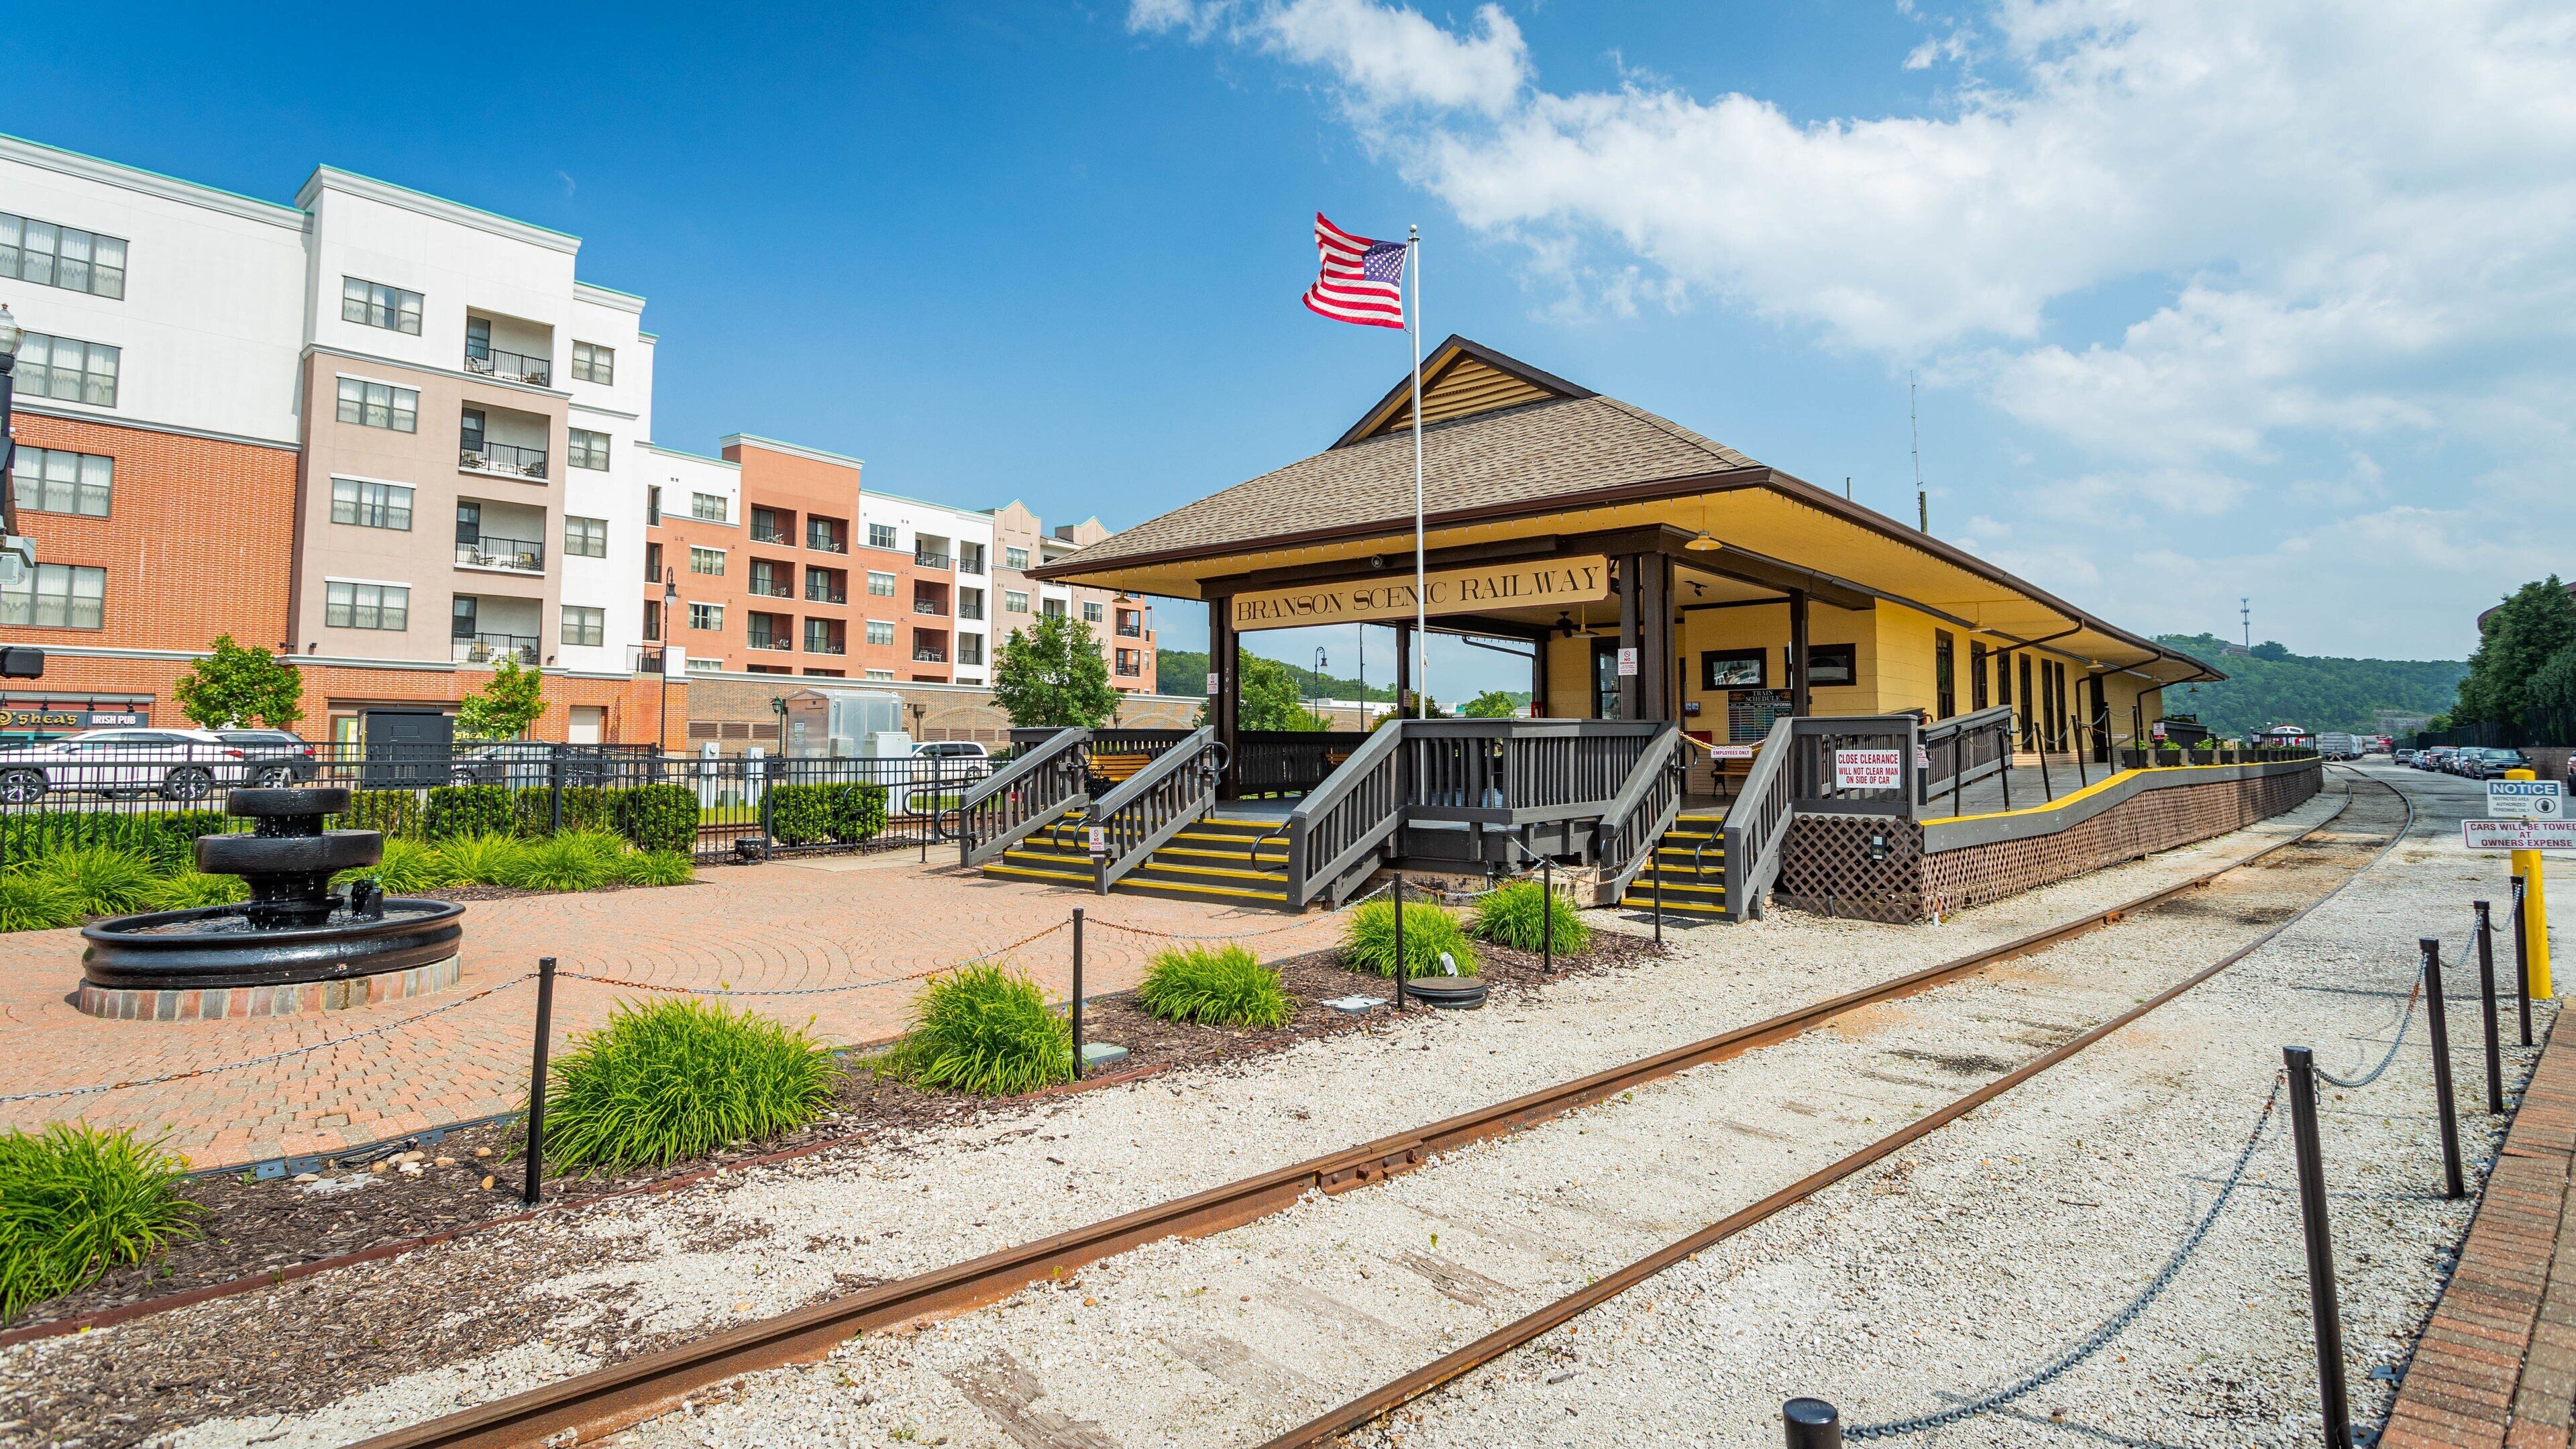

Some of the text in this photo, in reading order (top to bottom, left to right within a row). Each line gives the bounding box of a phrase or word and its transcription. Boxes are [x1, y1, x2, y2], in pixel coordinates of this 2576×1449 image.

[1236, 566, 1601, 621] BRANSON SCENIC RAILWAY
[92, 714, 116, 724] IRISH
[117, 715, 137, 724] PUB
[1838, 753, 1898, 764] CLOSE CLEARANCE
[1838, 767, 1898, 775] WILL NOT CLEAR MAN
[1846, 775, 1890, 784] ON SIDE OF CAR
[2492, 784, 2556, 795] NOTICE
[2470, 823, 2496, 831] CARS
[2527, 839, 2573, 847] EXPENSE
